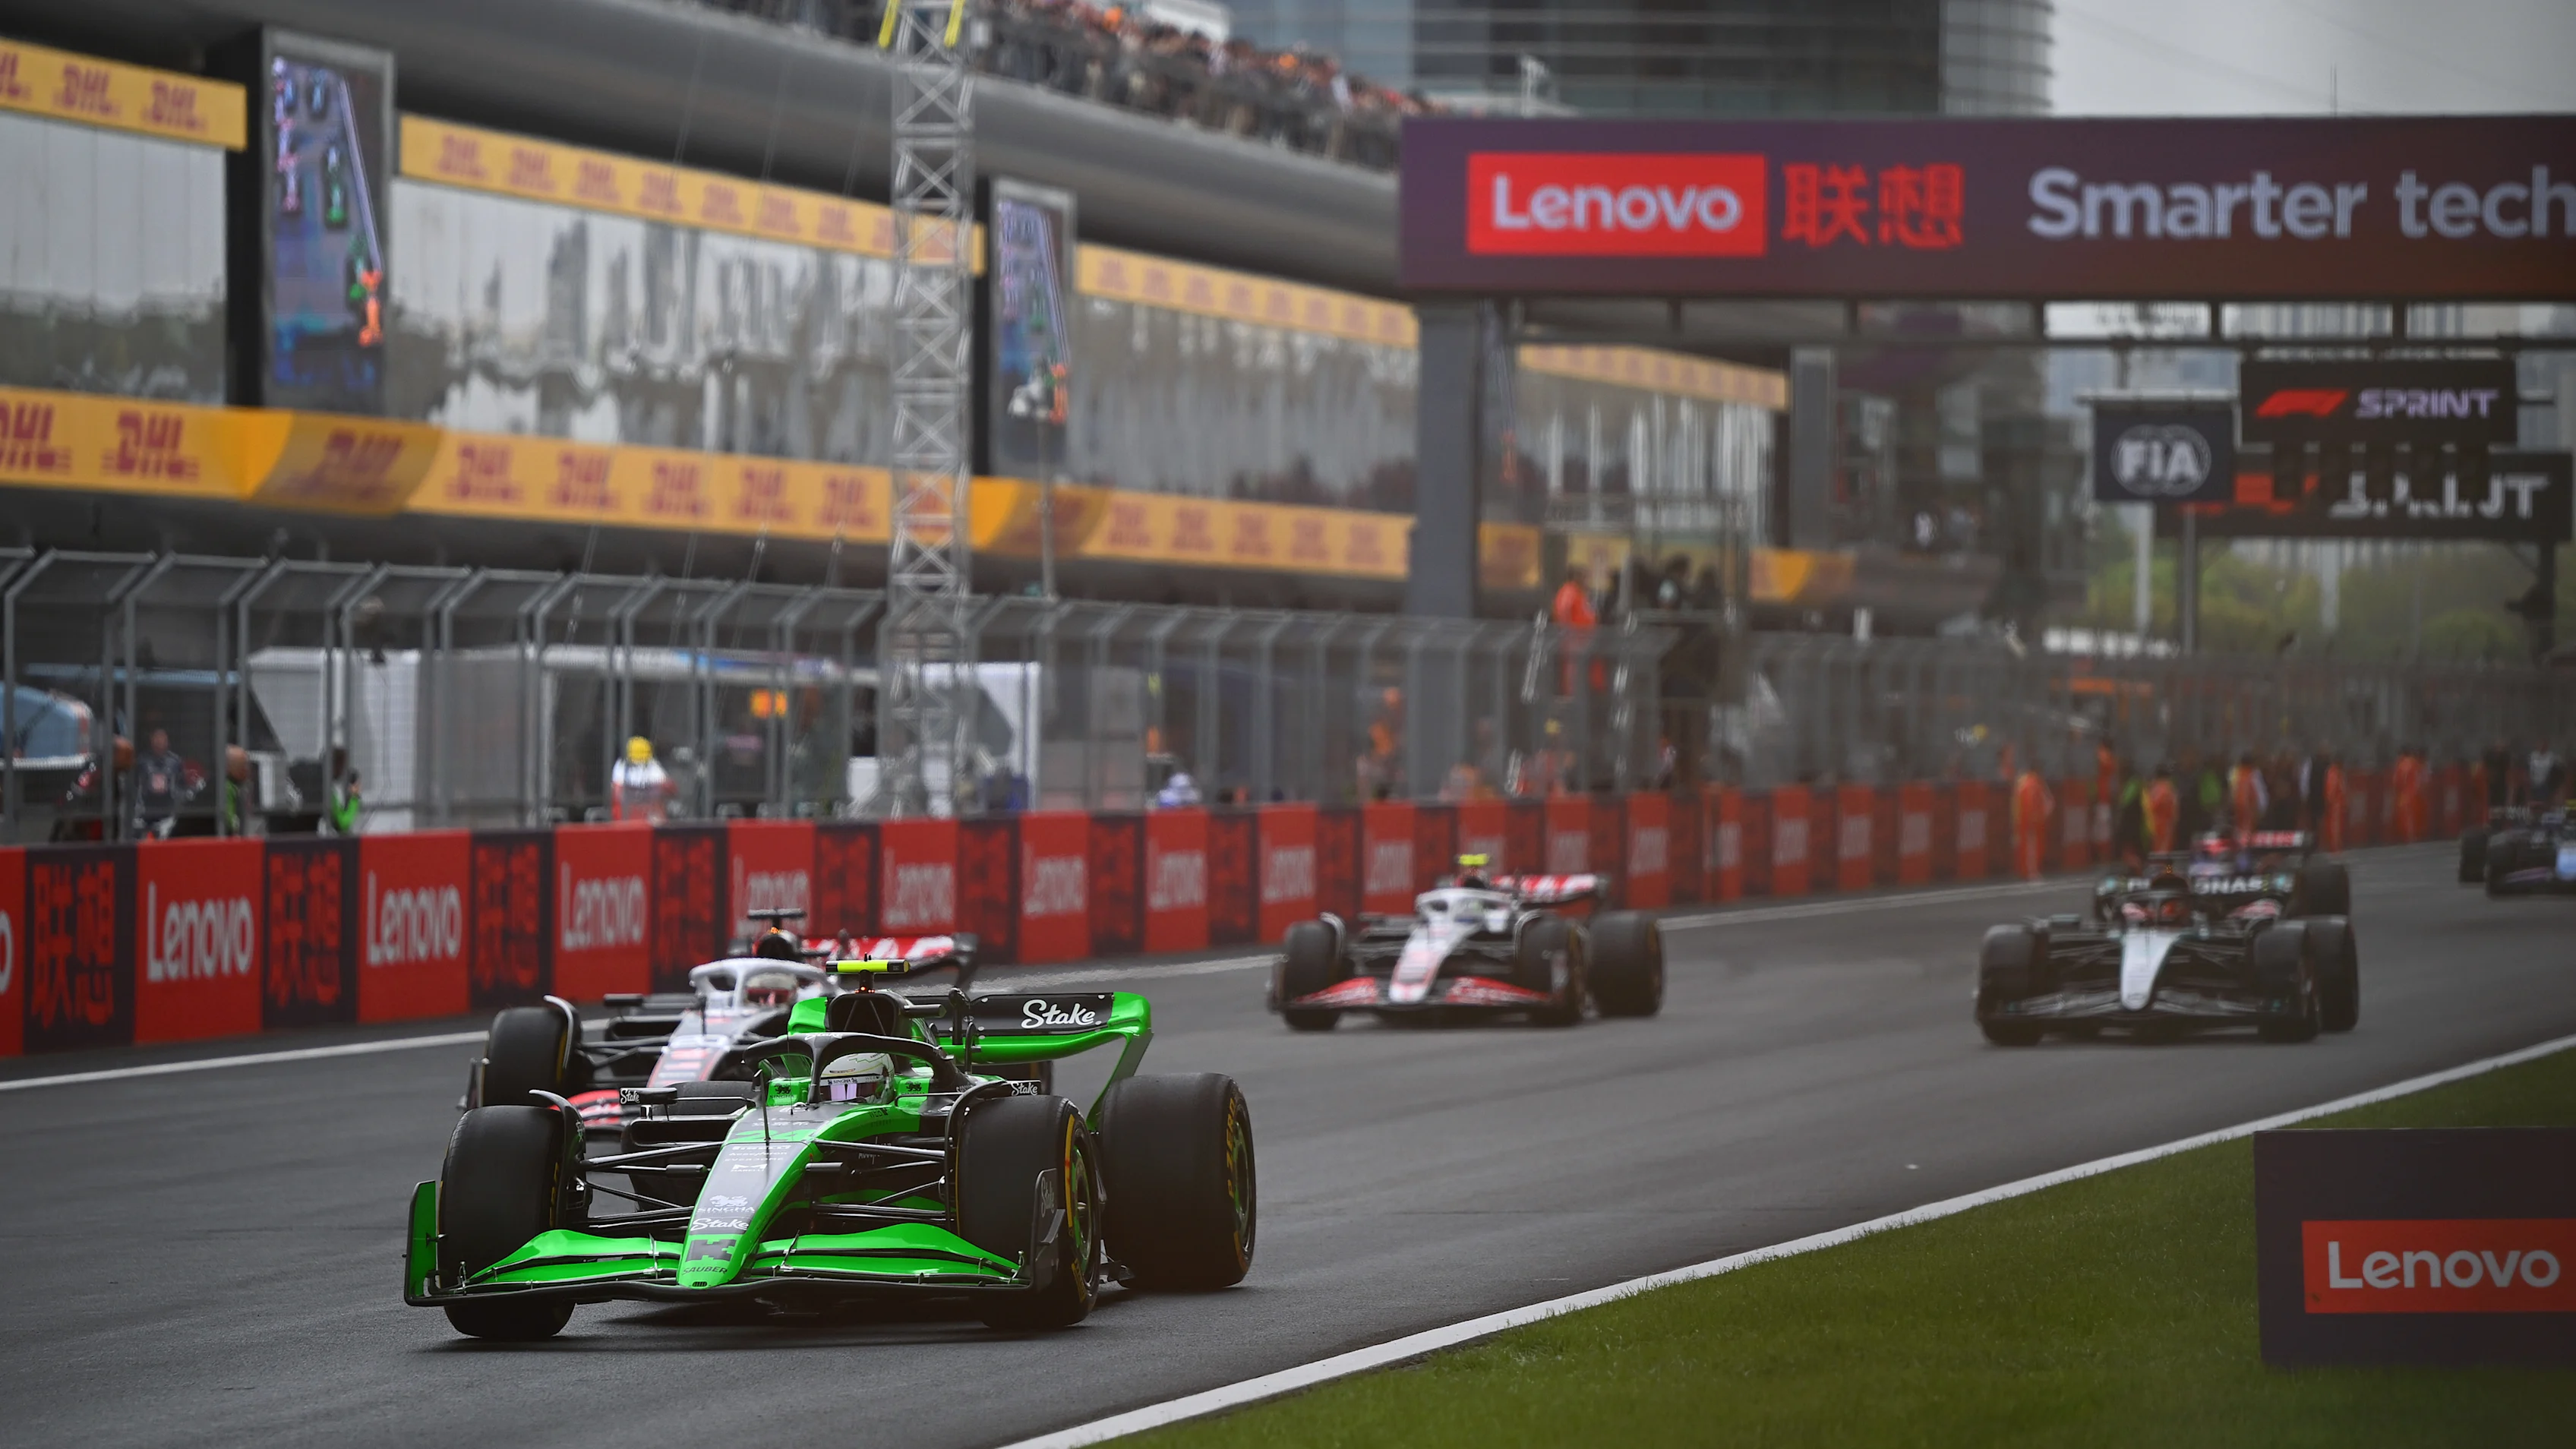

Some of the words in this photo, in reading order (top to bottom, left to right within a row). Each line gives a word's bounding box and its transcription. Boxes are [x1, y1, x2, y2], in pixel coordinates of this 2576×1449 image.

[1492, 172, 1741, 231] Lenovo
[1782, 162, 1965, 249] 联想
[2027, 166, 2368, 238] Smarter
[2394, 164, 2576, 238] tech
[2356, 388, 2499, 418] SPRINT
[117, 409, 187, 474] DHL
[2117, 440, 2208, 484] FIA
[147, 879, 254, 983] Lenovo
[366, 870, 462, 967] Lenovo
[560, 860, 646, 951] Lenovo
[30, 860, 115, 1031] 联想
[1021, 999, 1095, 1029] Stake
[620, 1088, 640, 1104] Stake
[1011, 1081, 1038, 1097] Stake
[690, 1217, 750, 1231] Stake
[683, 1265, 728, 1274] SAUBER
[2328, 1240, 2561, 1290] Lenovo
